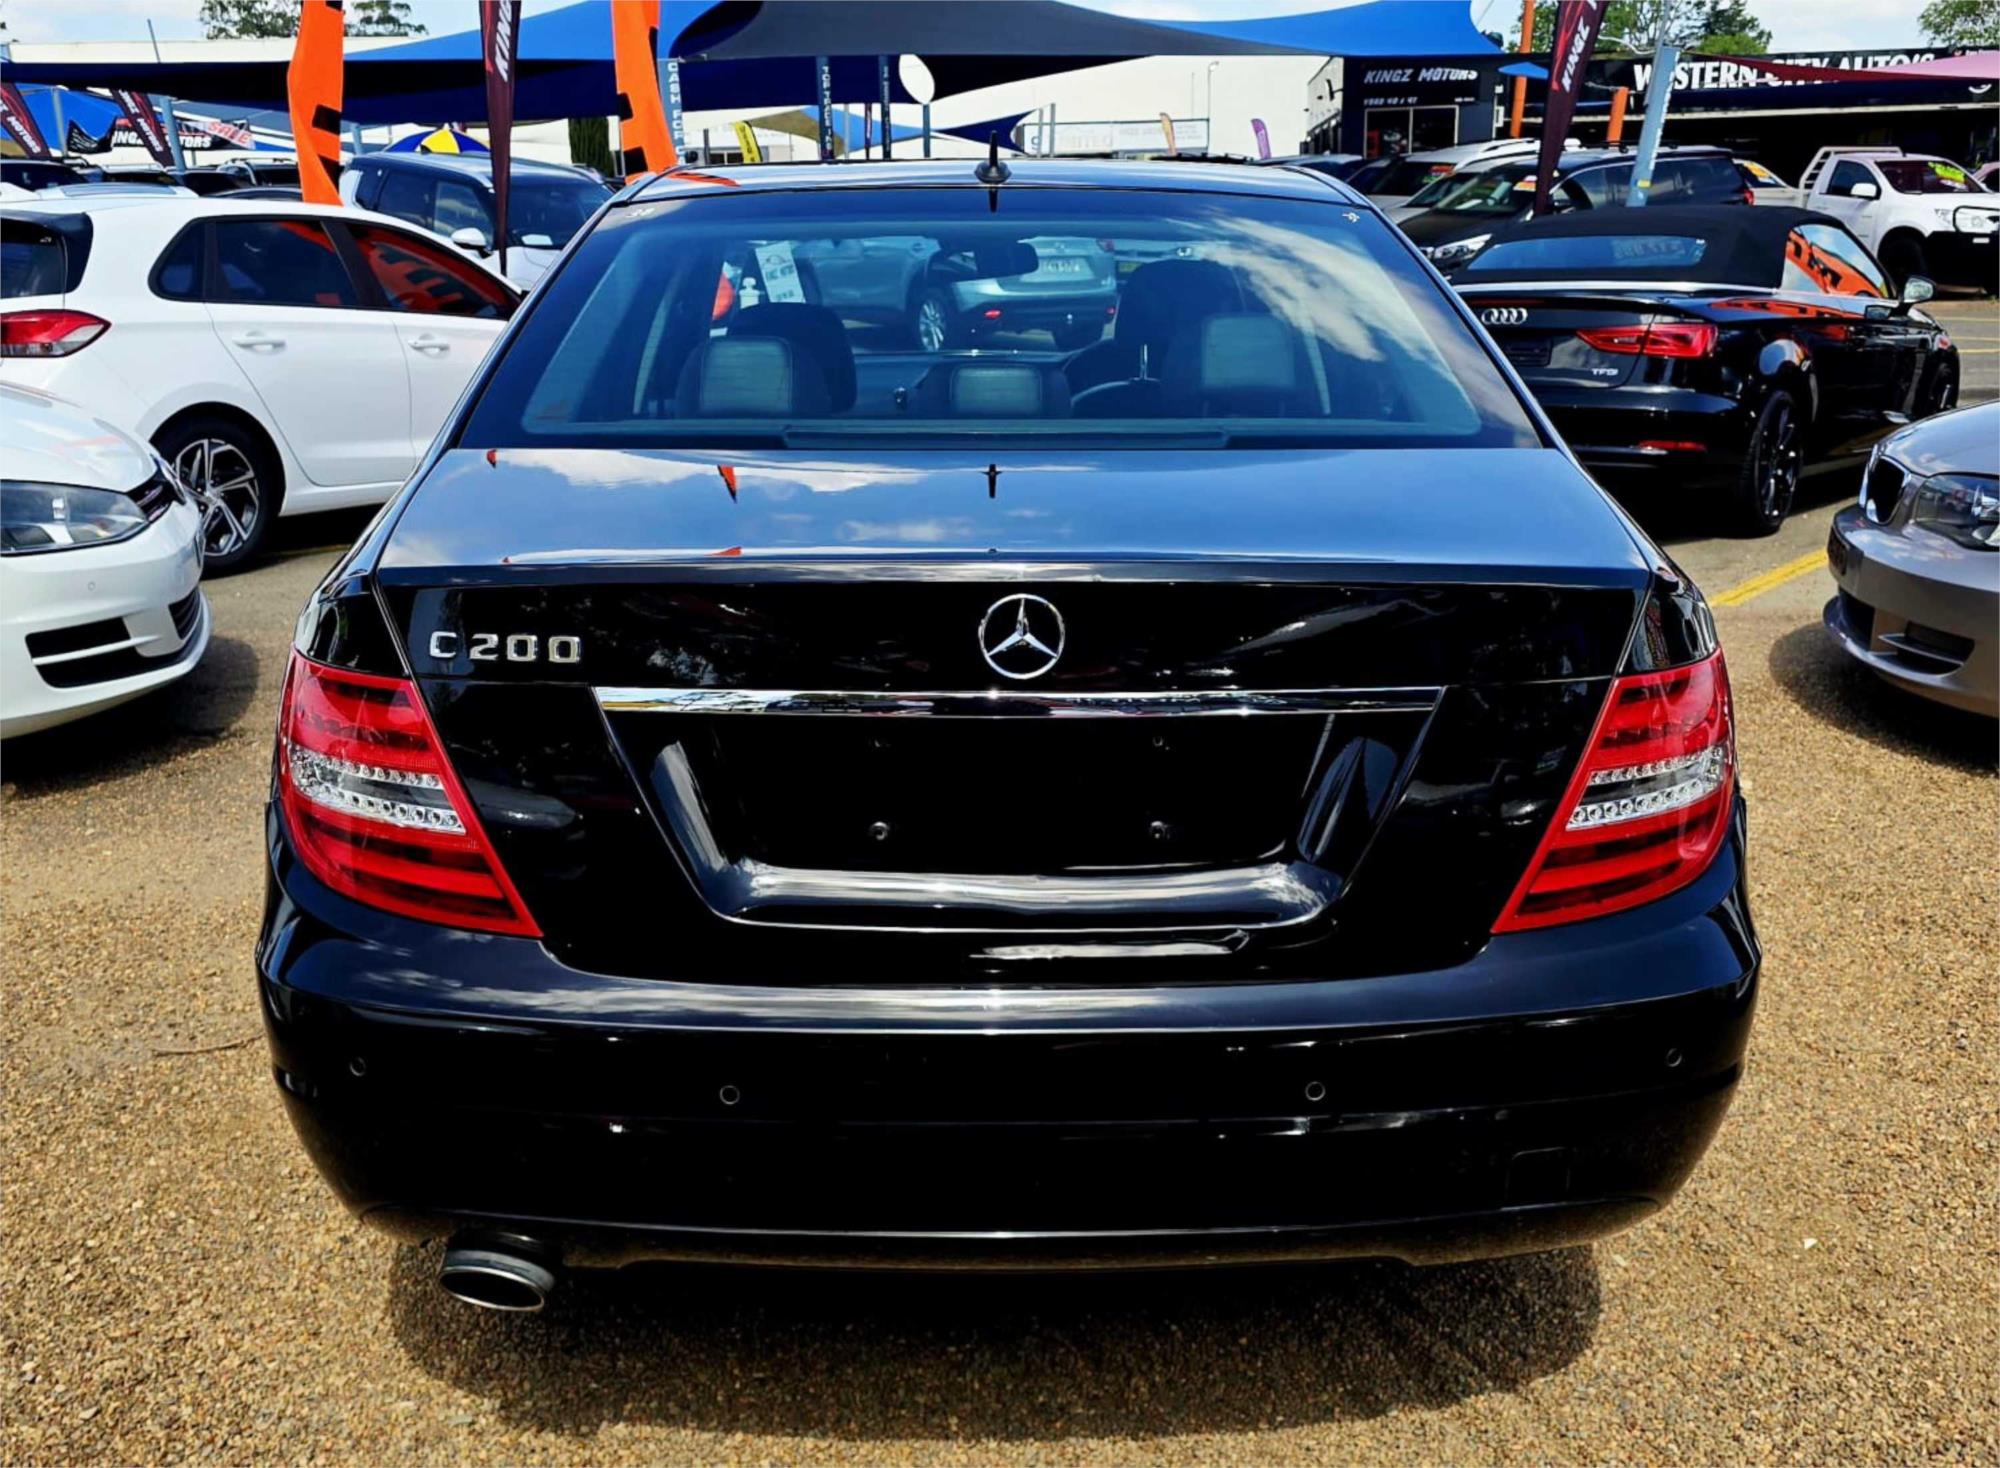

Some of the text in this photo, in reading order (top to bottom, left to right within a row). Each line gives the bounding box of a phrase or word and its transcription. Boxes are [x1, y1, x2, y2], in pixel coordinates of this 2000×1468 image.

[667, 62, 682, 104] CASH
[1363, 67, 1479, 84] KINGZ MOTORS
[1633, 61, 1758, 92] WSTERN
[208, 121, 252, 145] SALE
[429, 630, 582, 664] C 200
